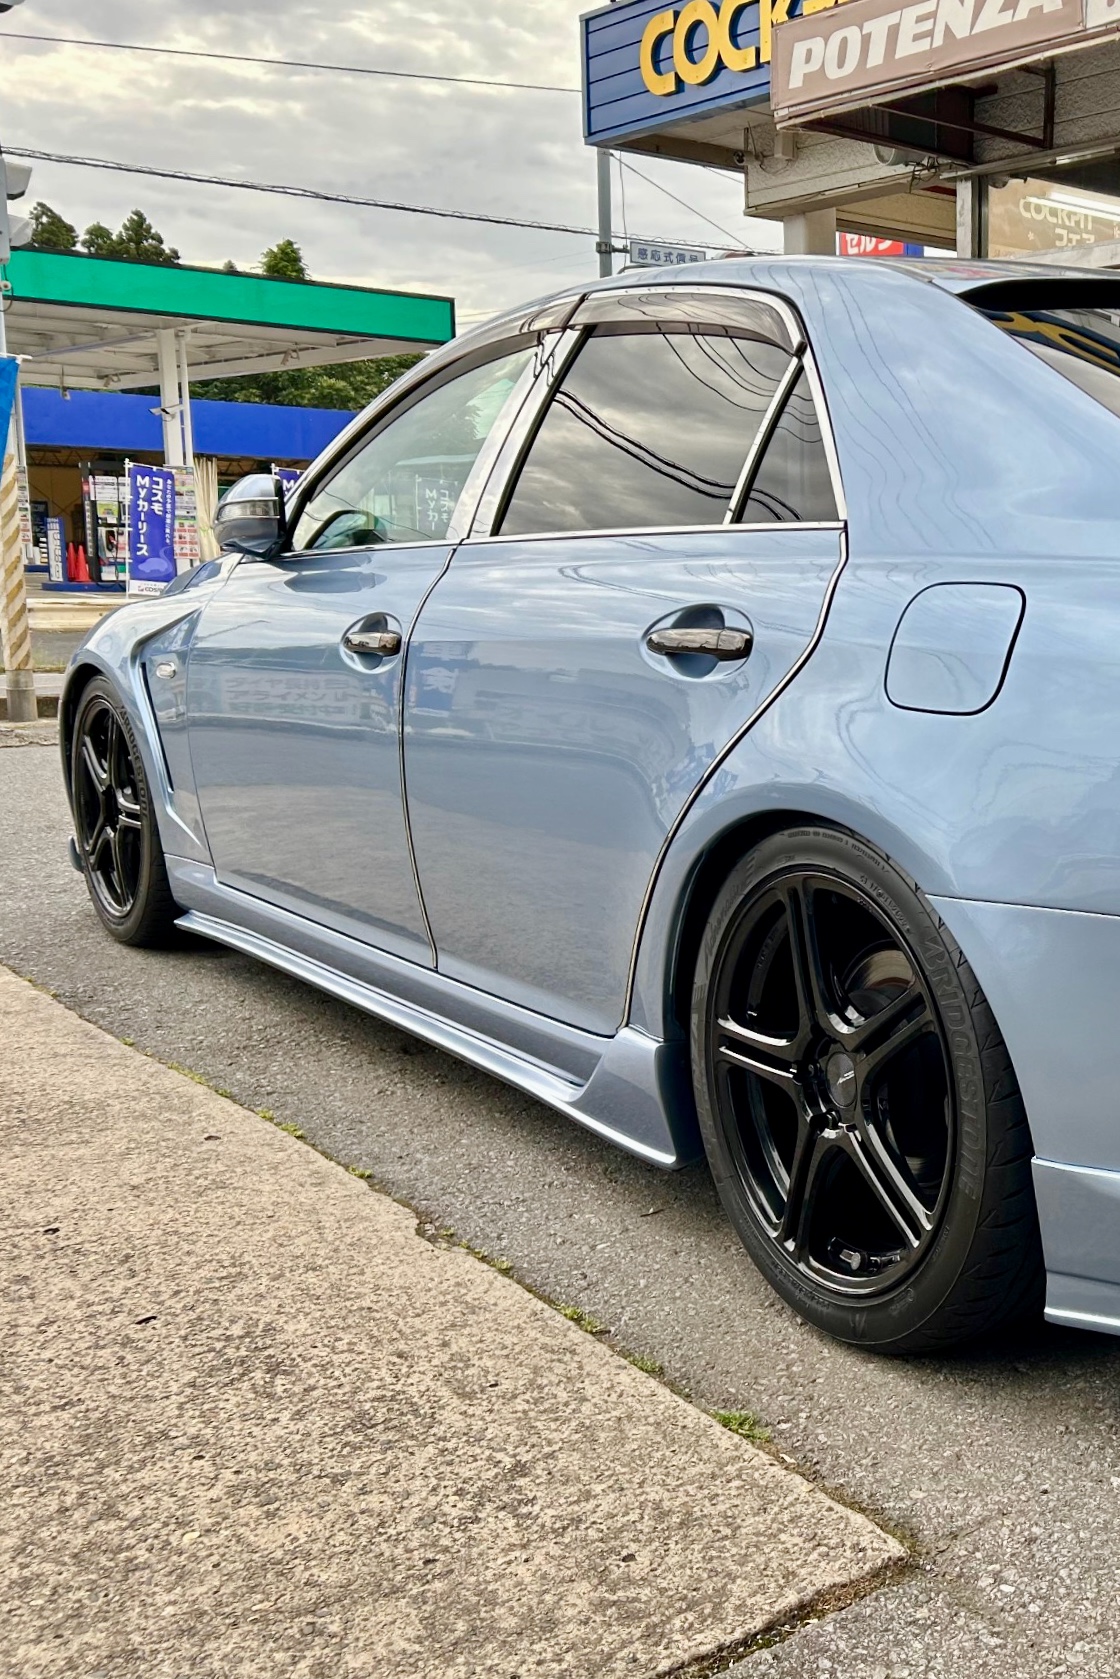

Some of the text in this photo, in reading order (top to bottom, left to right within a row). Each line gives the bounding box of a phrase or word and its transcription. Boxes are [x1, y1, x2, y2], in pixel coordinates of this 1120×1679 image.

[638, 0, 842, 97] COCK
[135, 474, 150, 557] Myカーリース
[151, 476, 164, 516] コスモ
[916, 935, 983, 1201] BRIDGESTONE
